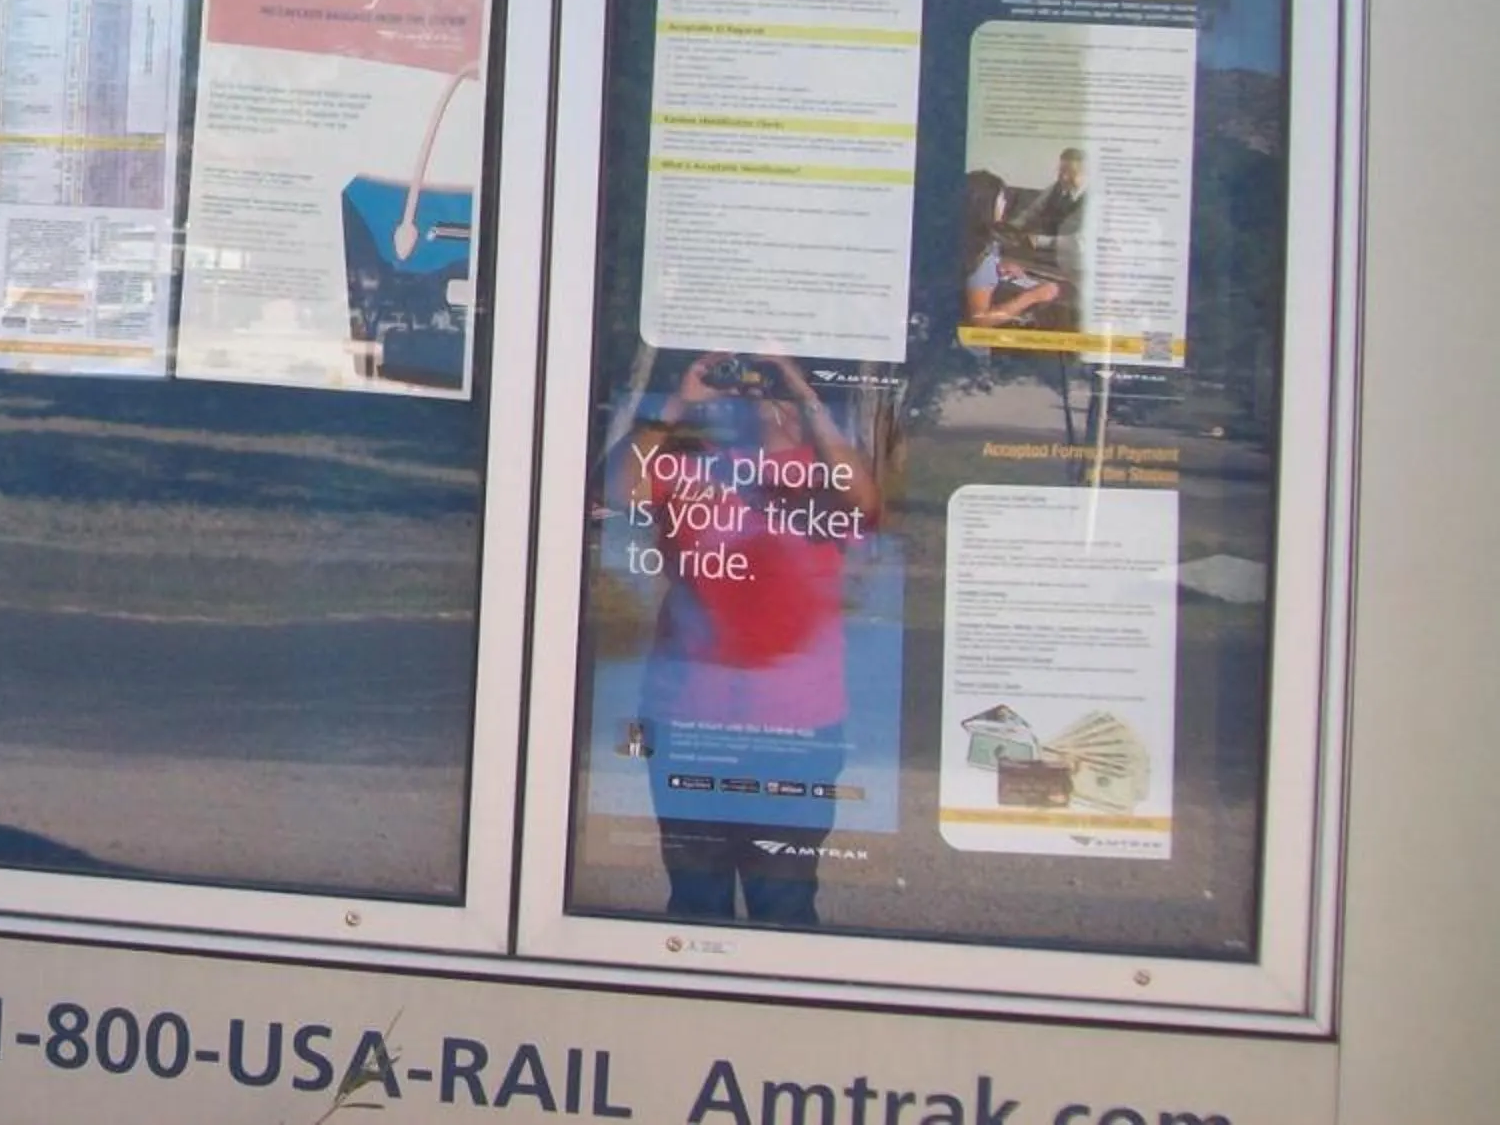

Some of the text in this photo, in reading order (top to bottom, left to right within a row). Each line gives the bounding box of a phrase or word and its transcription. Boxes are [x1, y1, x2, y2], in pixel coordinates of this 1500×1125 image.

[632, 442, 718, 482] Your
[732, 447, 853, 493] phone
[628, 491, 865, 540] is your ticket
[627, 541, 755, 581] to ride.
[784, 845, 869, 861] AMTRAK
